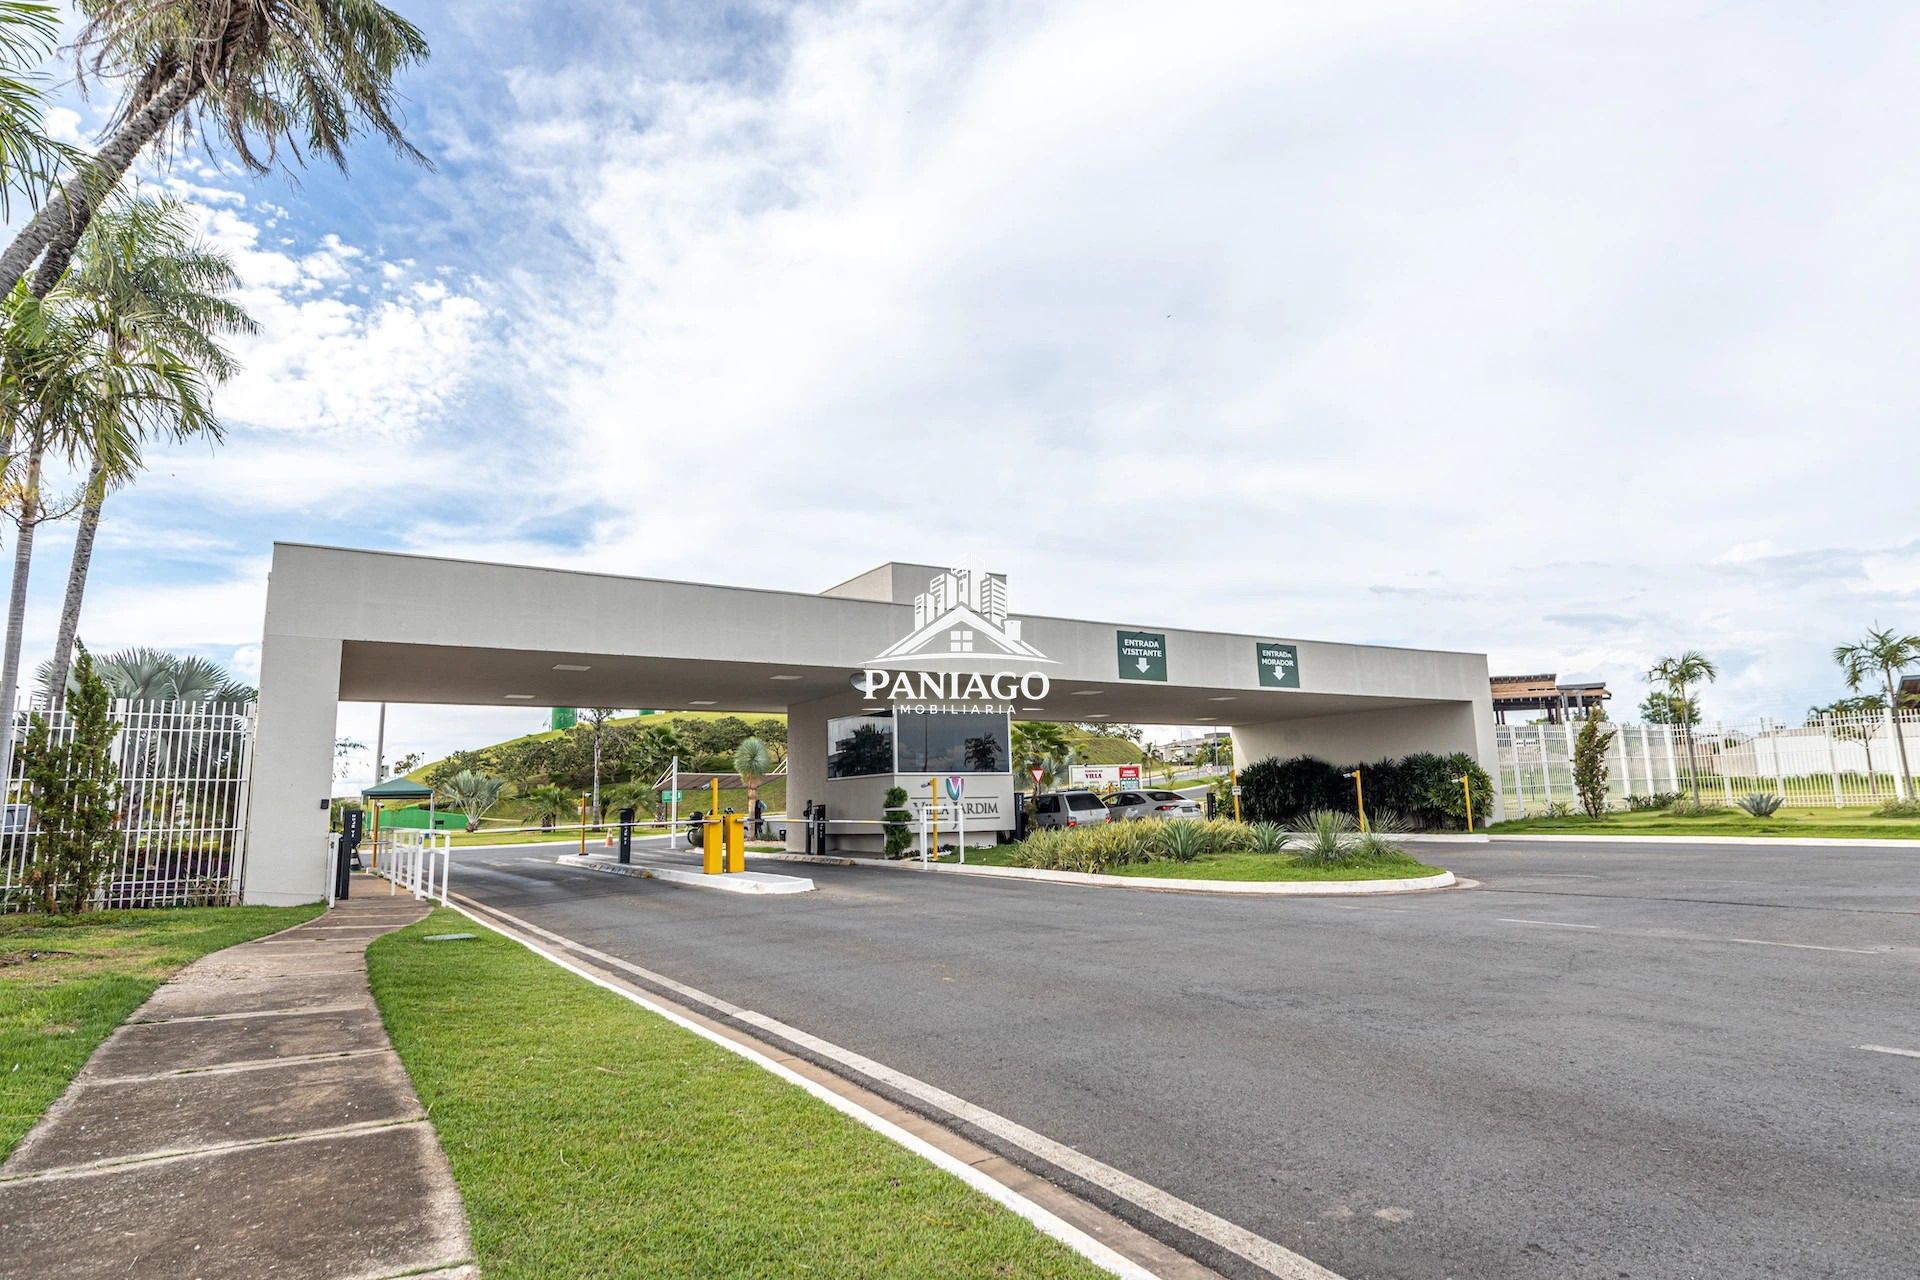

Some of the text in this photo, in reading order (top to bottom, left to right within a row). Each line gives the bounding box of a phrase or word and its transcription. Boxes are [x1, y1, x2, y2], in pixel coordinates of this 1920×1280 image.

[1124, 639, 1159, 648] ENTRADA
[1122, 648, 1162, 657] VISITANTE
[1262, 650, 1292, 658] ENTRADA
[1261, 658, 1294, 667] MORADOR
